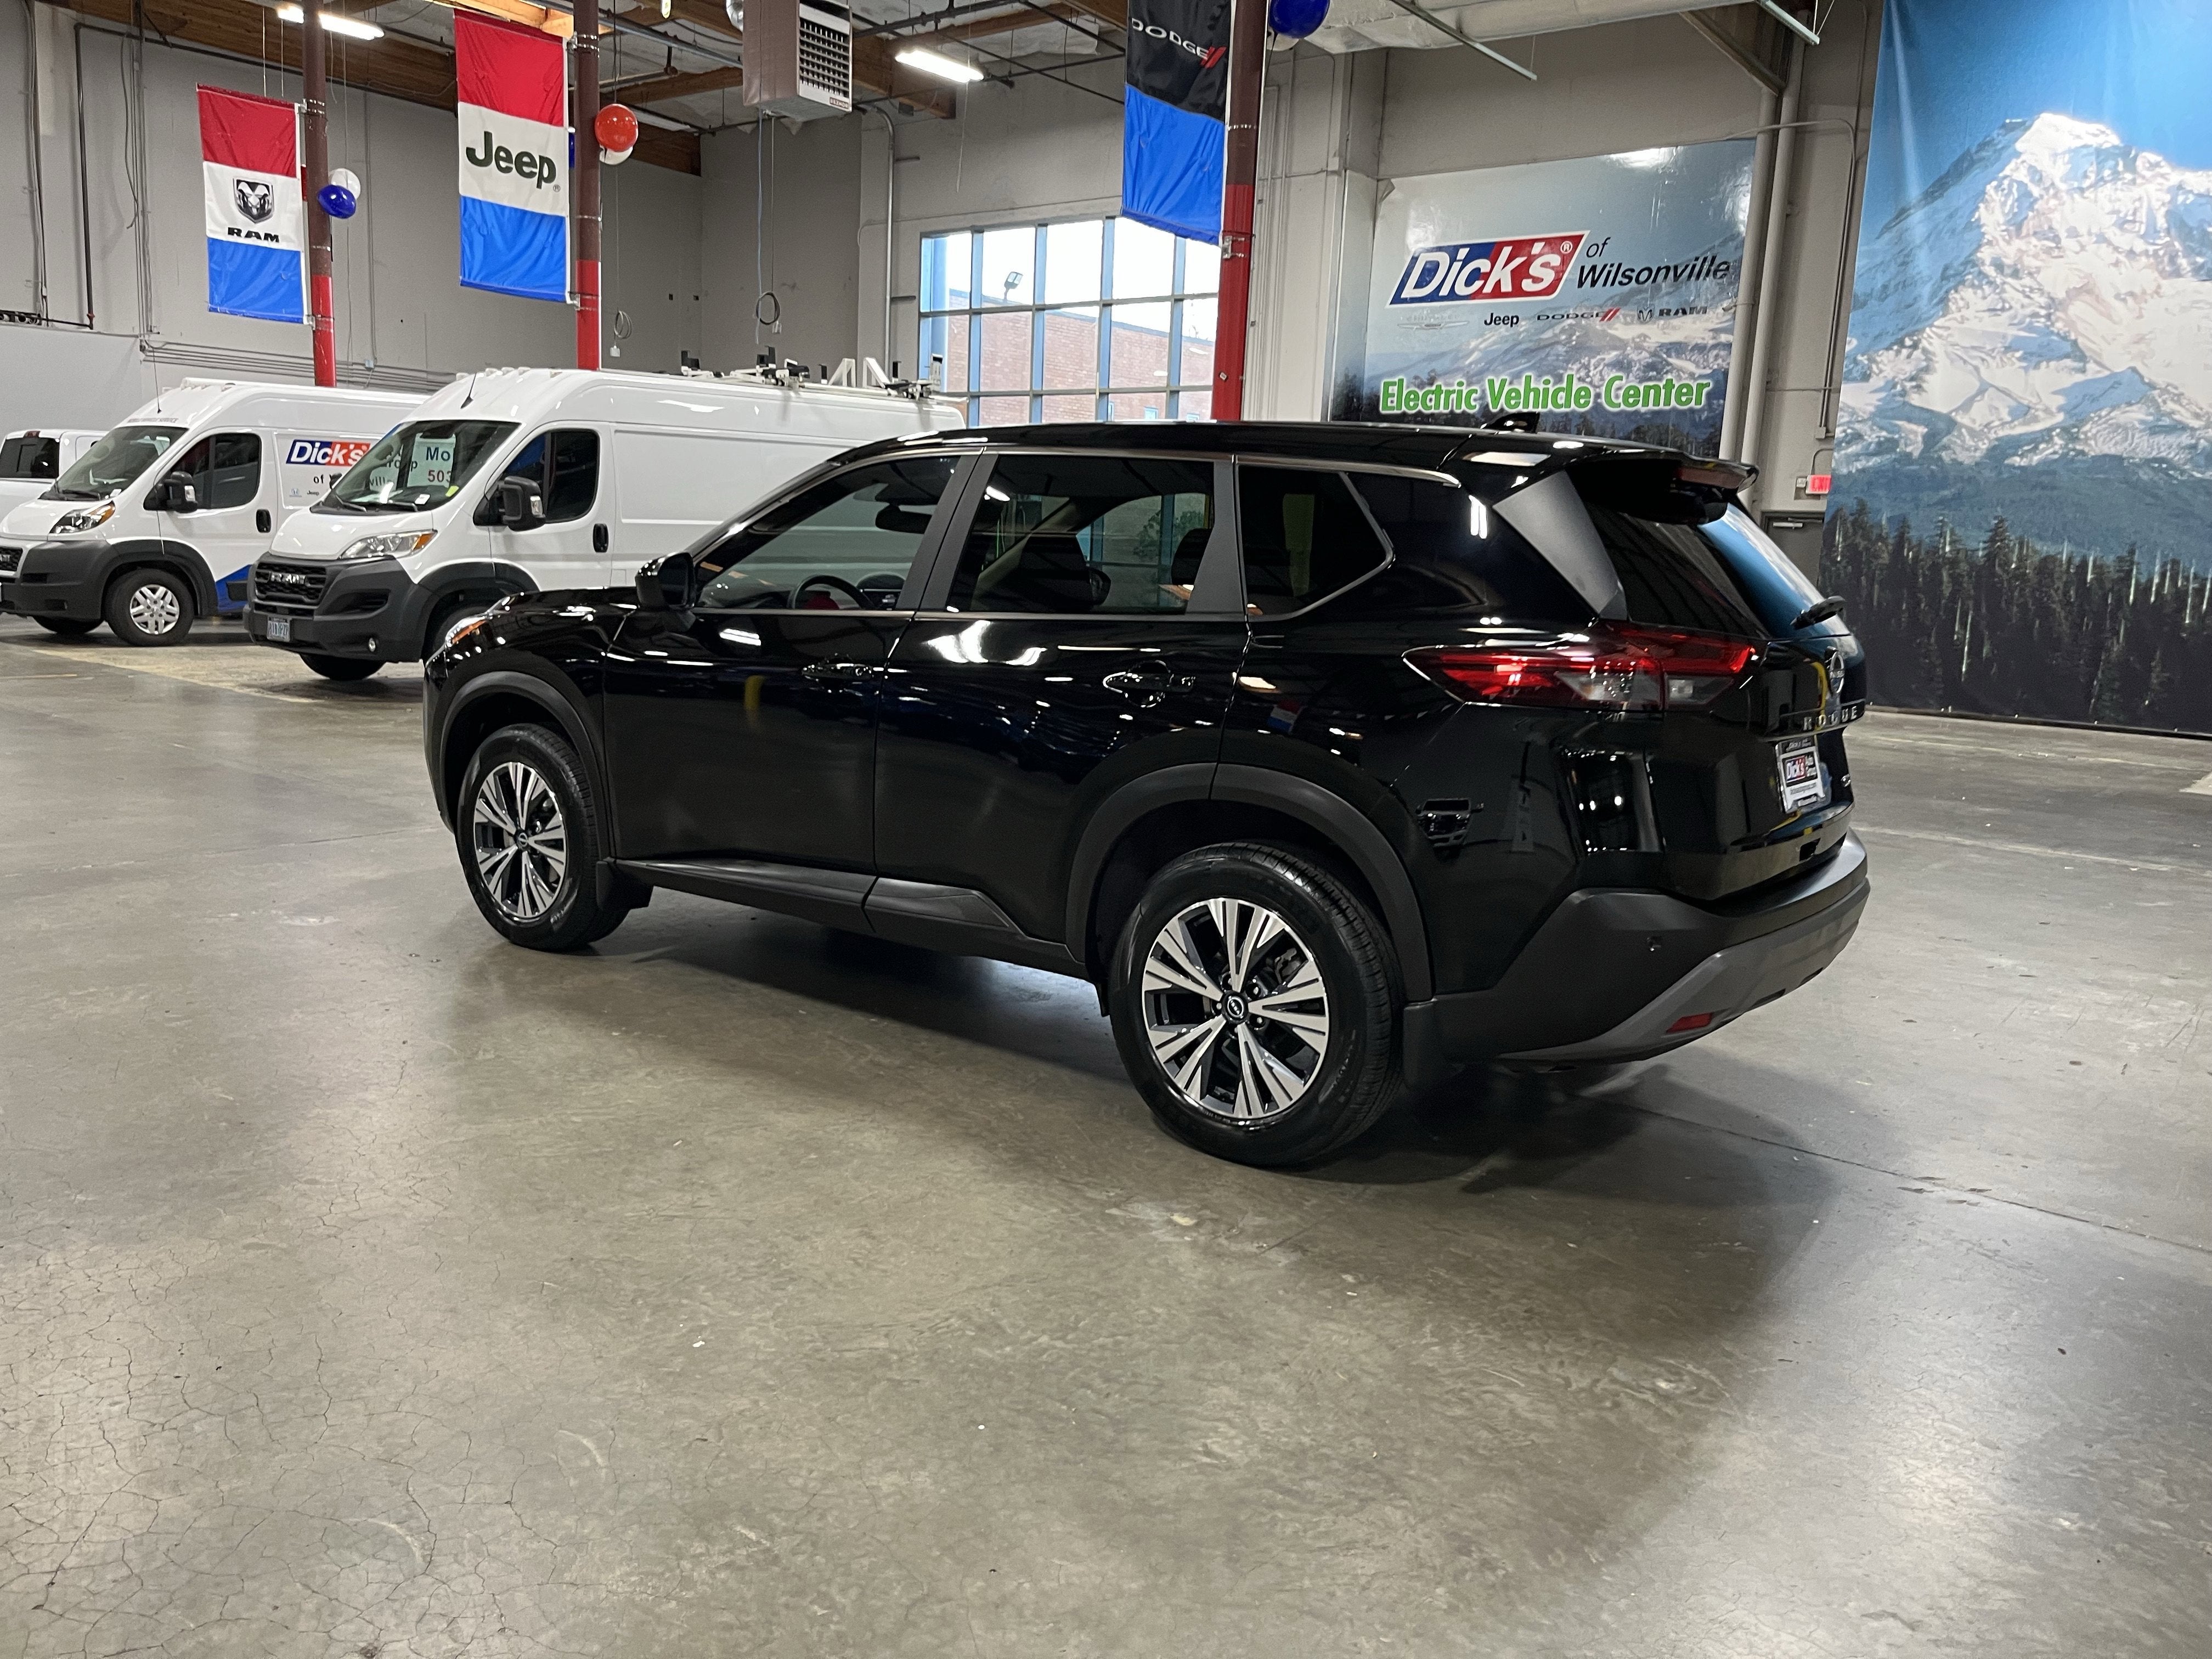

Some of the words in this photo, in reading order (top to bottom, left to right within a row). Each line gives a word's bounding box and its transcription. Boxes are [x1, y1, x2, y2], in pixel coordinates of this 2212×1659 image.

[1131, 18, 1209, 60] DODGE
[466, 131, 556, 189] Jeep
[228, 227, 280, 243] RAM
[1585, 236, 1611, 258] of
[1577, 253, 1730, 289] Wilsonville
[1484, 313, 1520, 328] Jeep
[1537, 311, 1606, 321] DODGE
[1658, 306, 1708, 317] RAM
[1381, 378, 1478, 411] Electric
[1487, 374, 1592, 410] Vehicle
[1604, 374, 1711, 408] Center
[313, 475, 324, 484] of
